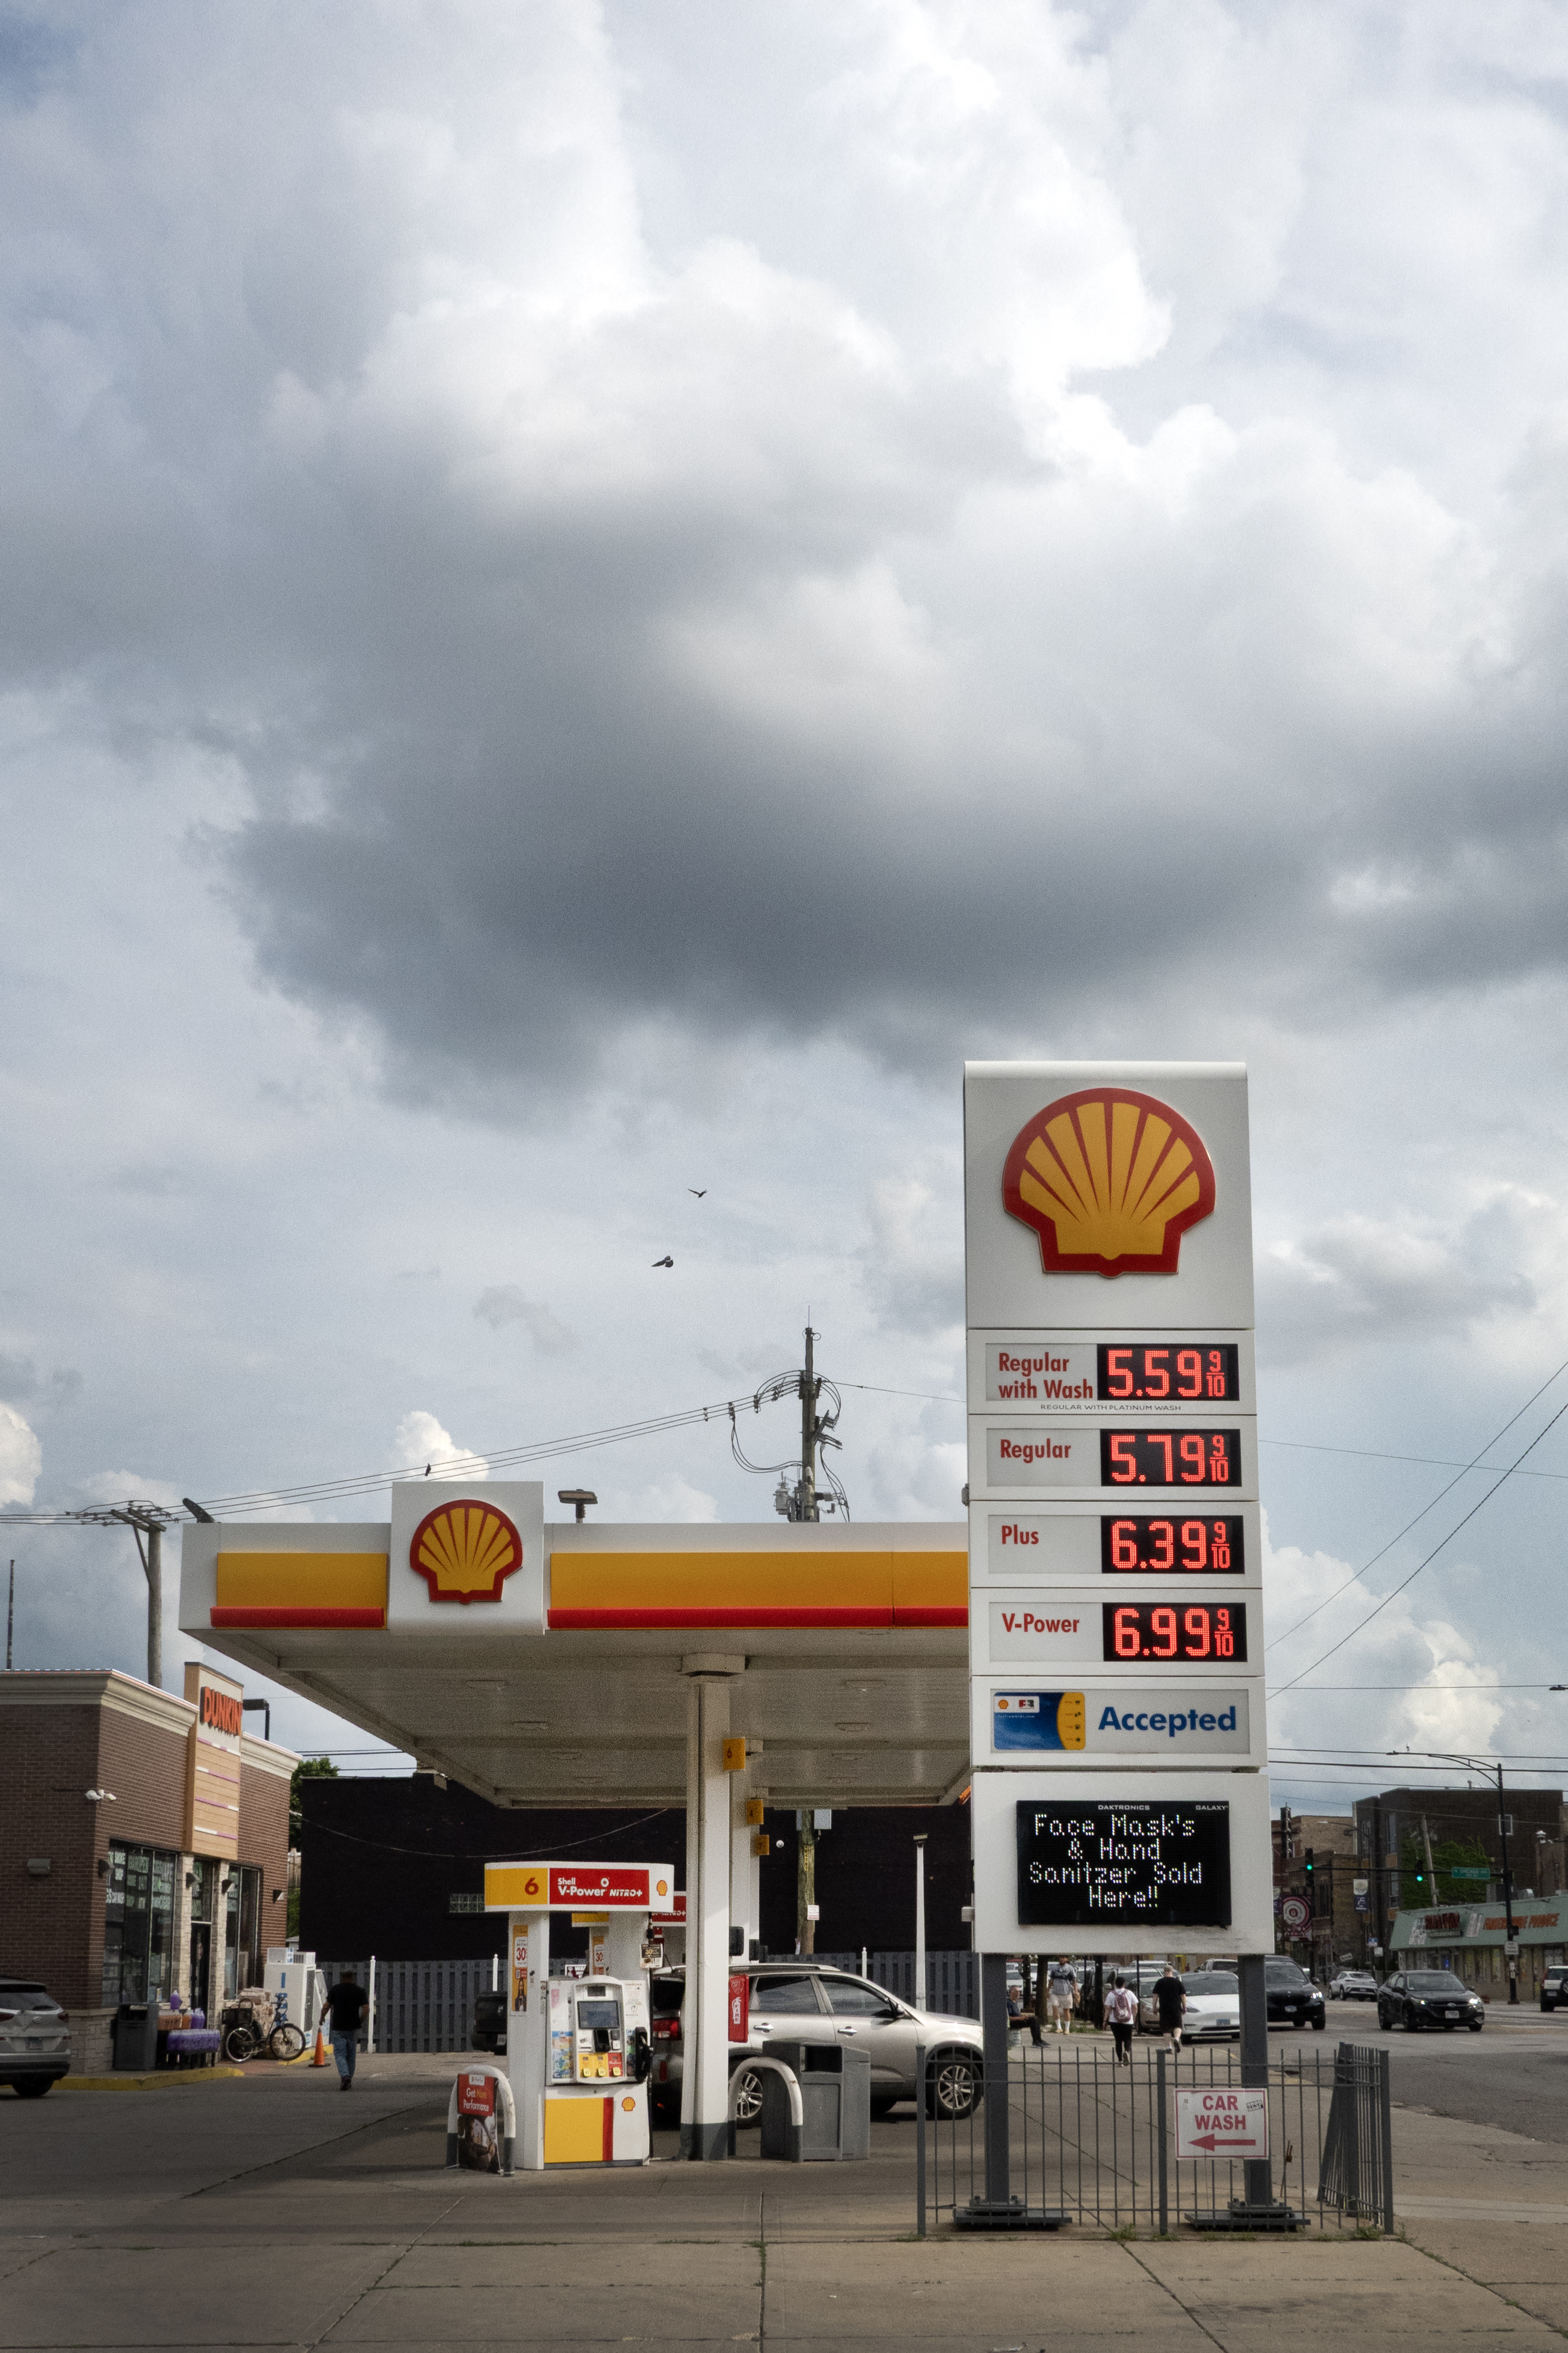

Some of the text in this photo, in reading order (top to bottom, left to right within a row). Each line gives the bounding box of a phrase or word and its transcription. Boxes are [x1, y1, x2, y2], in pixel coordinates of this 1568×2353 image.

[999, 1352, 1069, 1376] Regular
[1108, 1350, 1202, 1397] 5.59
[999, 1379, 1093, 1398] with Wash
[1000, 1438, 1071, 1463] Regular
[1111, 1434, 1205, 1482] 5.79
[1001, 1525, 1039, 1545] Plus
[1111, 1520, 1207, 1569] 6.39
[1002, 1613, 1080, 1632] V-Power
[1114, 1608, 1210, 1657] 6.99
[1098, 1706, 1236, 1737] Accepted
[1035, 1814, 1195, 1837] Face Mask's
[1068, 1838, 1160, 1860] & Hand
[557, 1877, 576, 1885] Shell
[1029, 1862, 1202, 1884] Sanitzer Sold
[524, 1877, 539, 1896] 6
[557, 1885, 643, 1897] V-Power NITRO+
[1089, 1885, 1158, 1908] Here!!
[466, 2087, 476, 2098] Get
[1203, 2095, 1238, 2111] CAR
[463, 2099, 489, 2112] Performance
[1194, 2114, 1246, 2130] WASH
